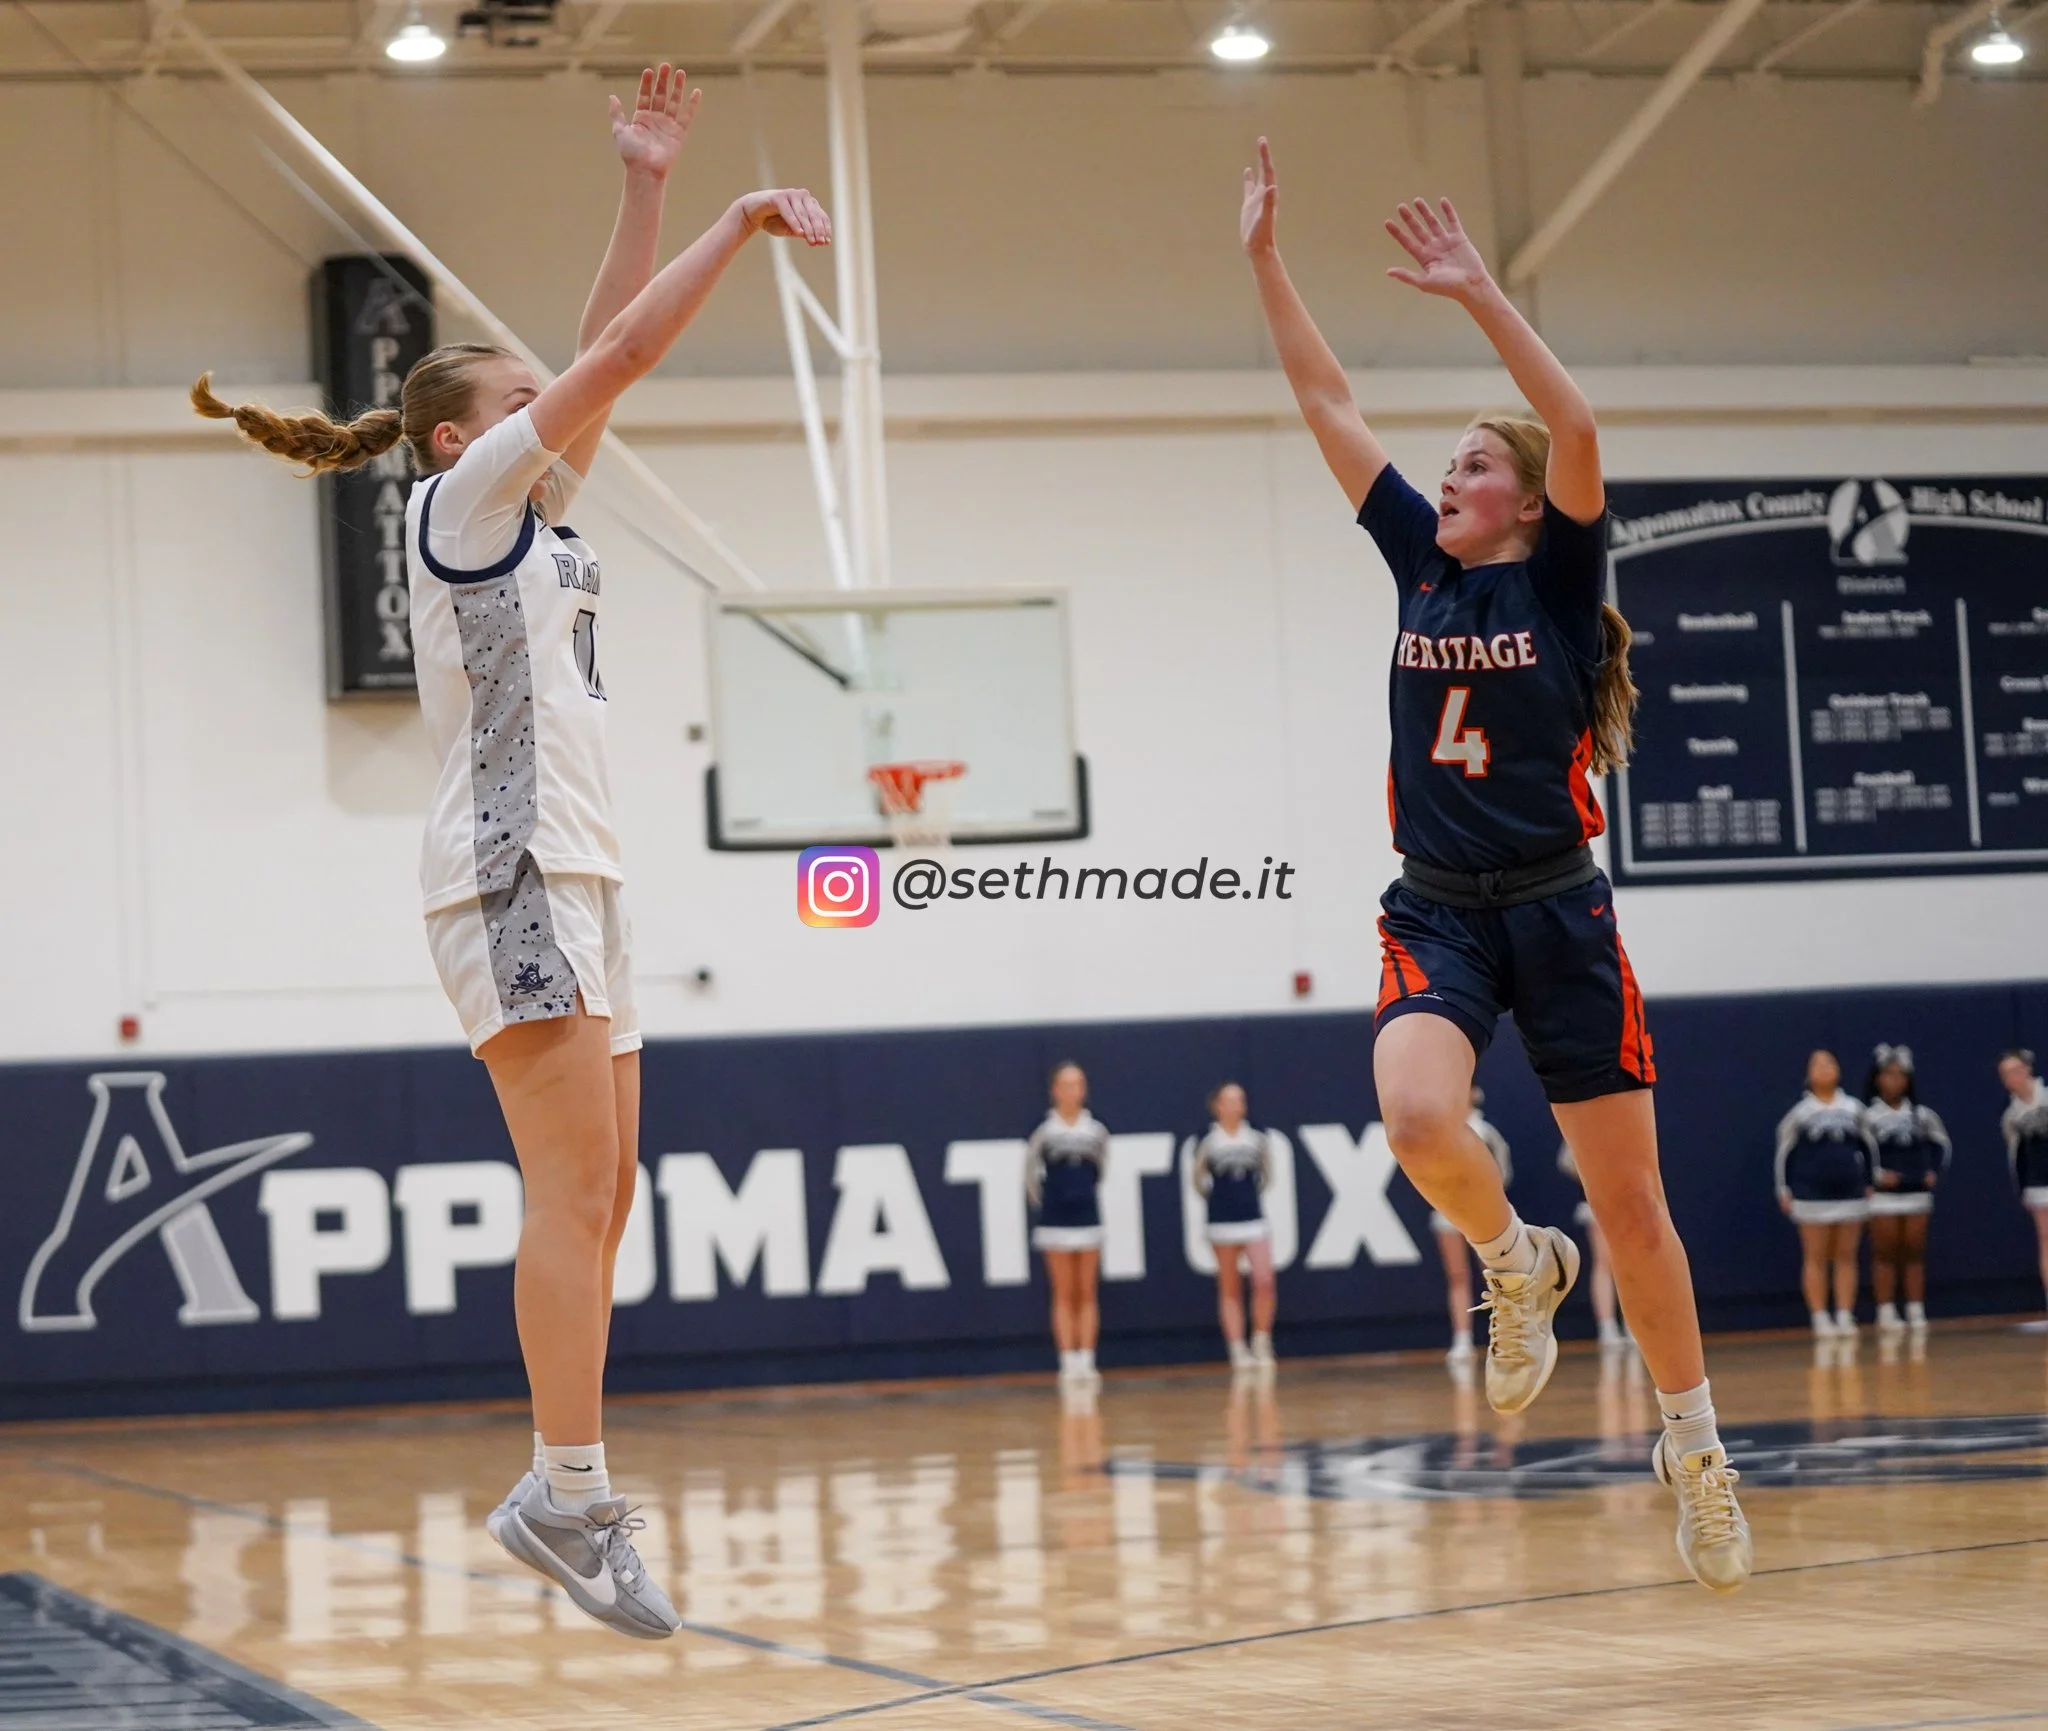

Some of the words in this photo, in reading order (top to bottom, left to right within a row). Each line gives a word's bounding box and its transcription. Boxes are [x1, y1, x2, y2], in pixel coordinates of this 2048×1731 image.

[355, 277, 412, 662] APPMATTOX
[1746, 490, 1828, 518] County
[1910, 485, 1968, 515] High
[1969, 488, 2045, 522] School
[1396, 630, 1538, 671] HERITAGE
[1430, 686, 1491, 777] 4
